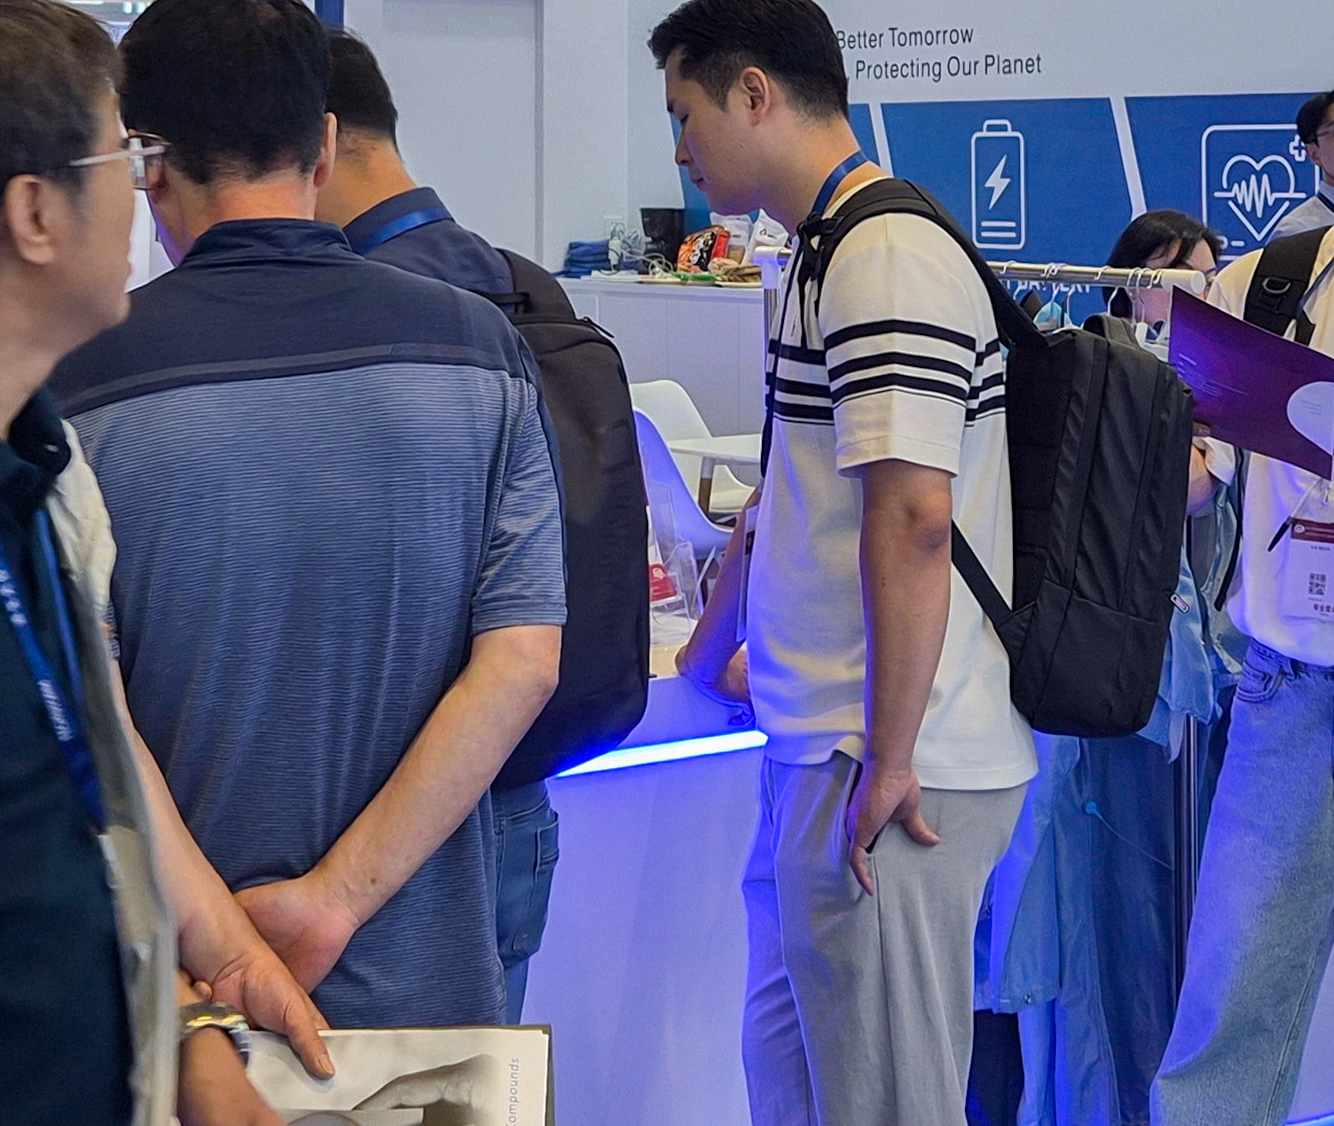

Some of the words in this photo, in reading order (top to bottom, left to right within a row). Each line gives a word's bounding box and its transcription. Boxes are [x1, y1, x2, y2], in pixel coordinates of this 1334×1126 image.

[888, 27, 974, 48] Tomorrow
[856, 58, 942, 83] Protecting
[947, 55, 980, 77] Our
[984, 54, 1042, 75] Planet
[506, 1057, 522, 1126] ompounds
